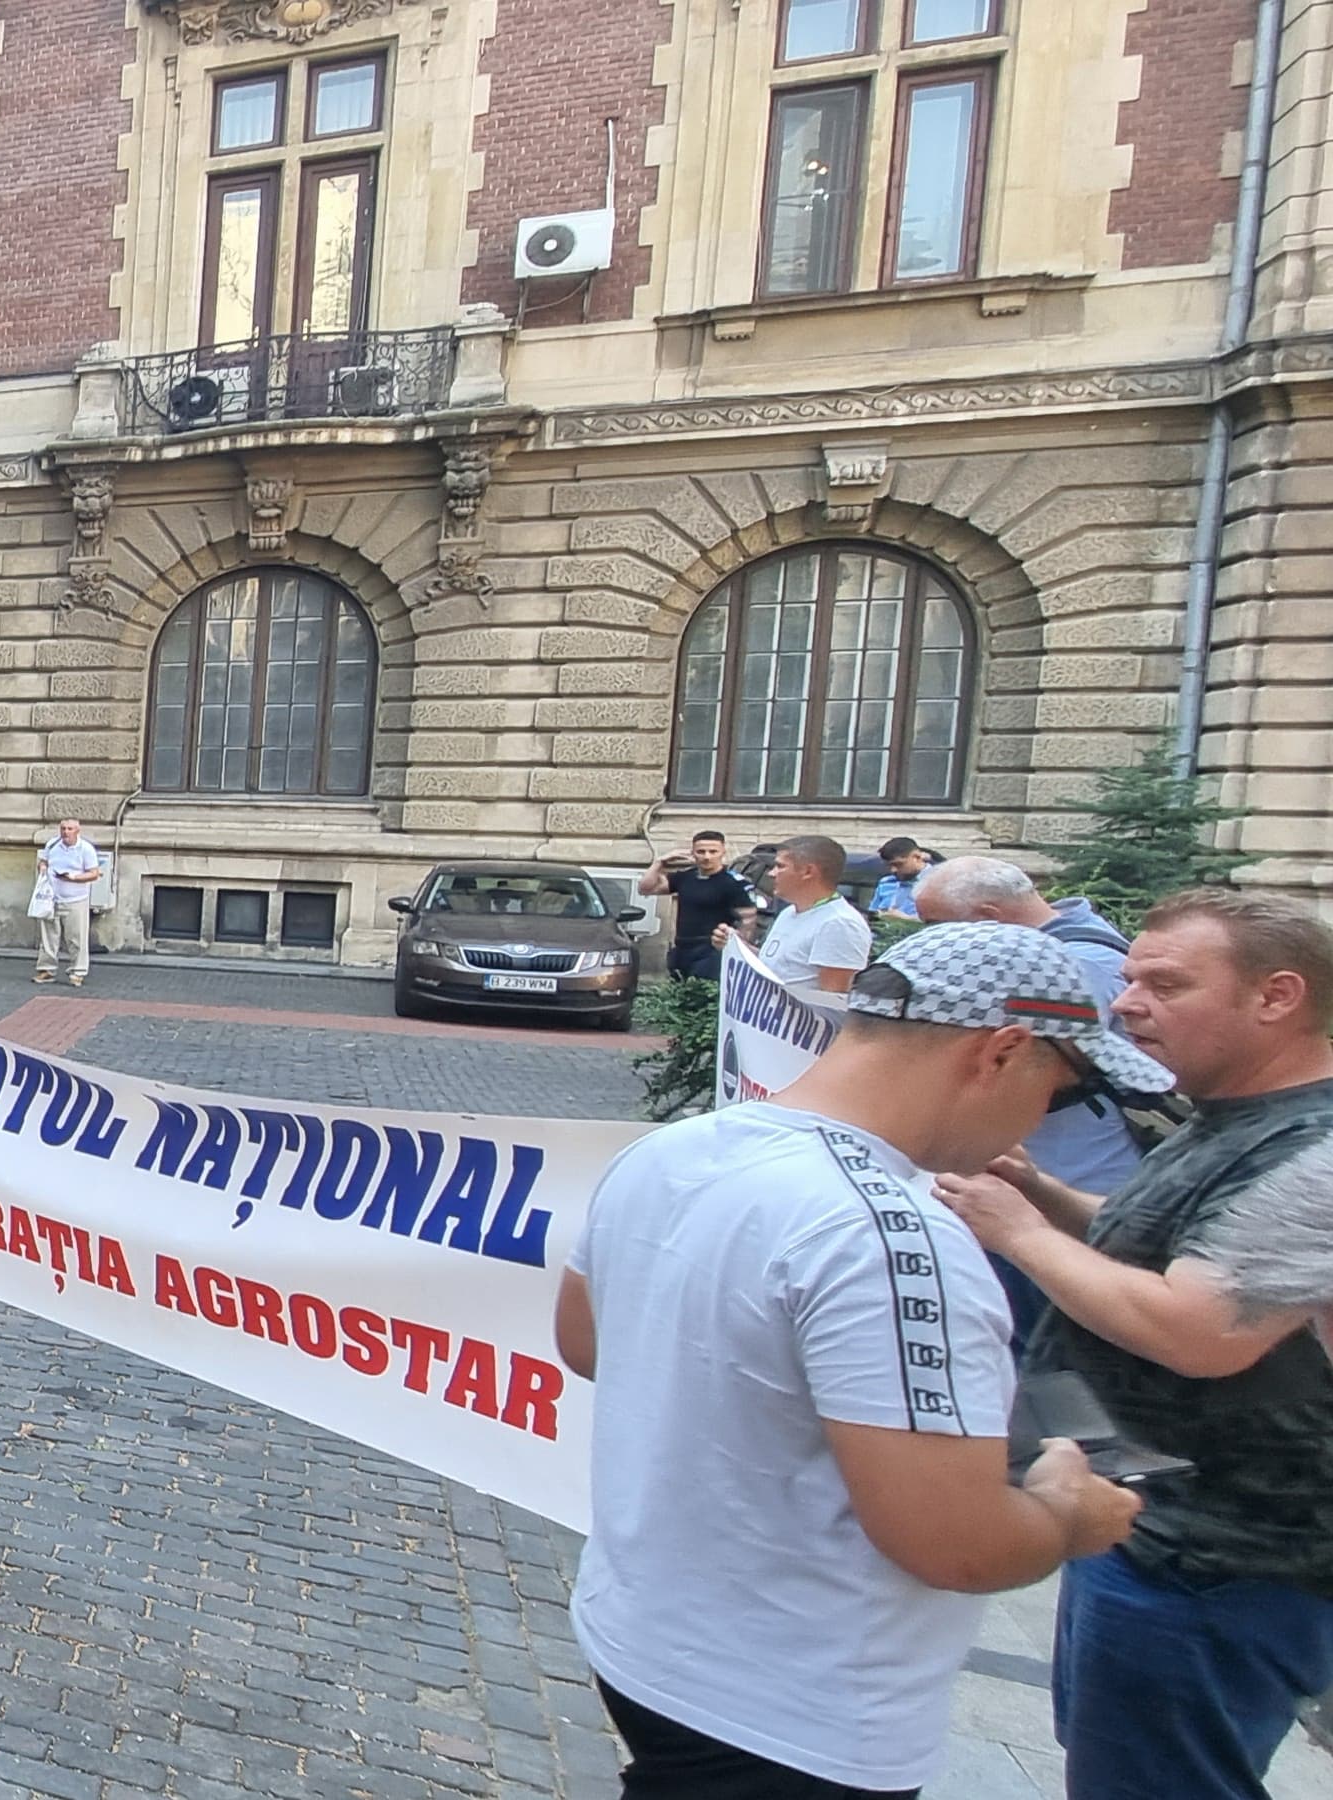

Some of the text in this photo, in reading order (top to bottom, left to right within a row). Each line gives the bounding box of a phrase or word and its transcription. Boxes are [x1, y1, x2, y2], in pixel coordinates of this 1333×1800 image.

[504, 977, 526, 988] 239
[528, 978, 555, 989] WMA
[135, 1094, 553, 1268] NAȚIONAL
[155, 1253, 564, 1441] AGROSTAR
